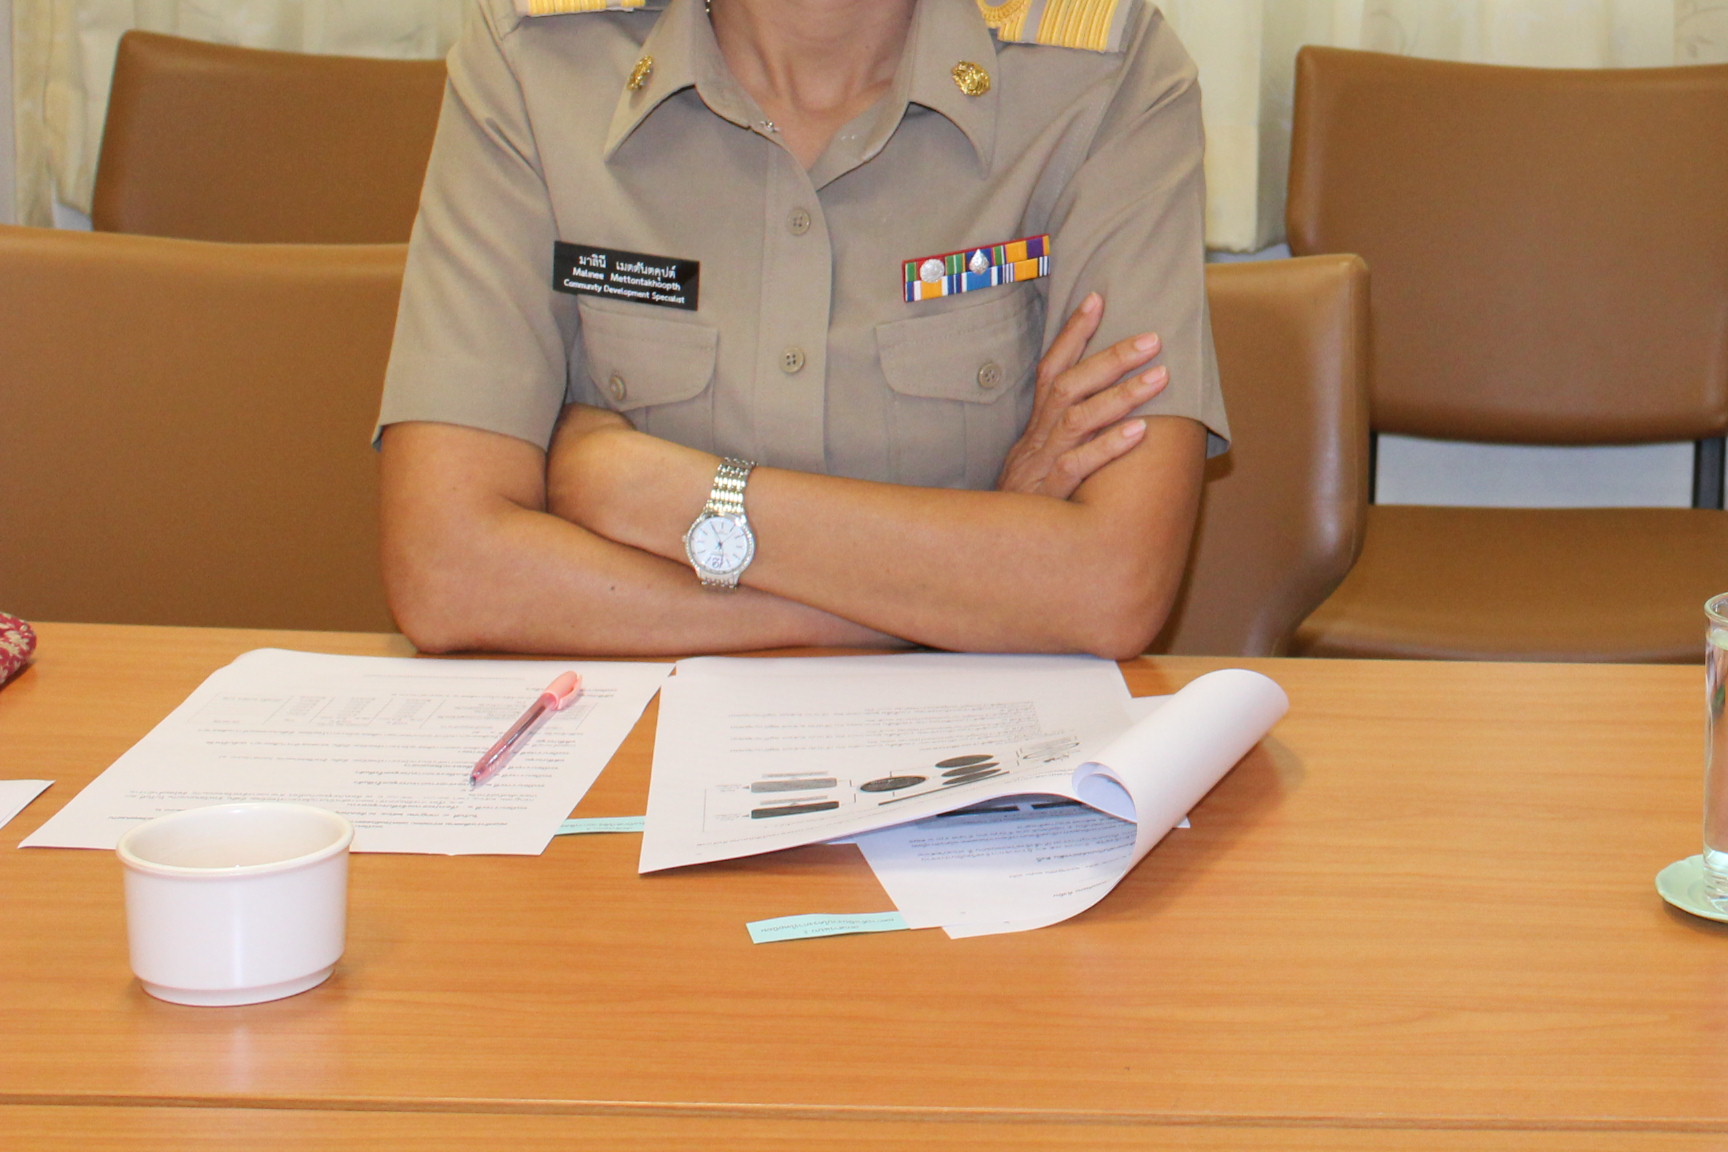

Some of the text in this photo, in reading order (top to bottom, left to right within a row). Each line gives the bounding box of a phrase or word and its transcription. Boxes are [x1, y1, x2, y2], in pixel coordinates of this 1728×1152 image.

[563, 278, 685, 303] Community Development Specialist
